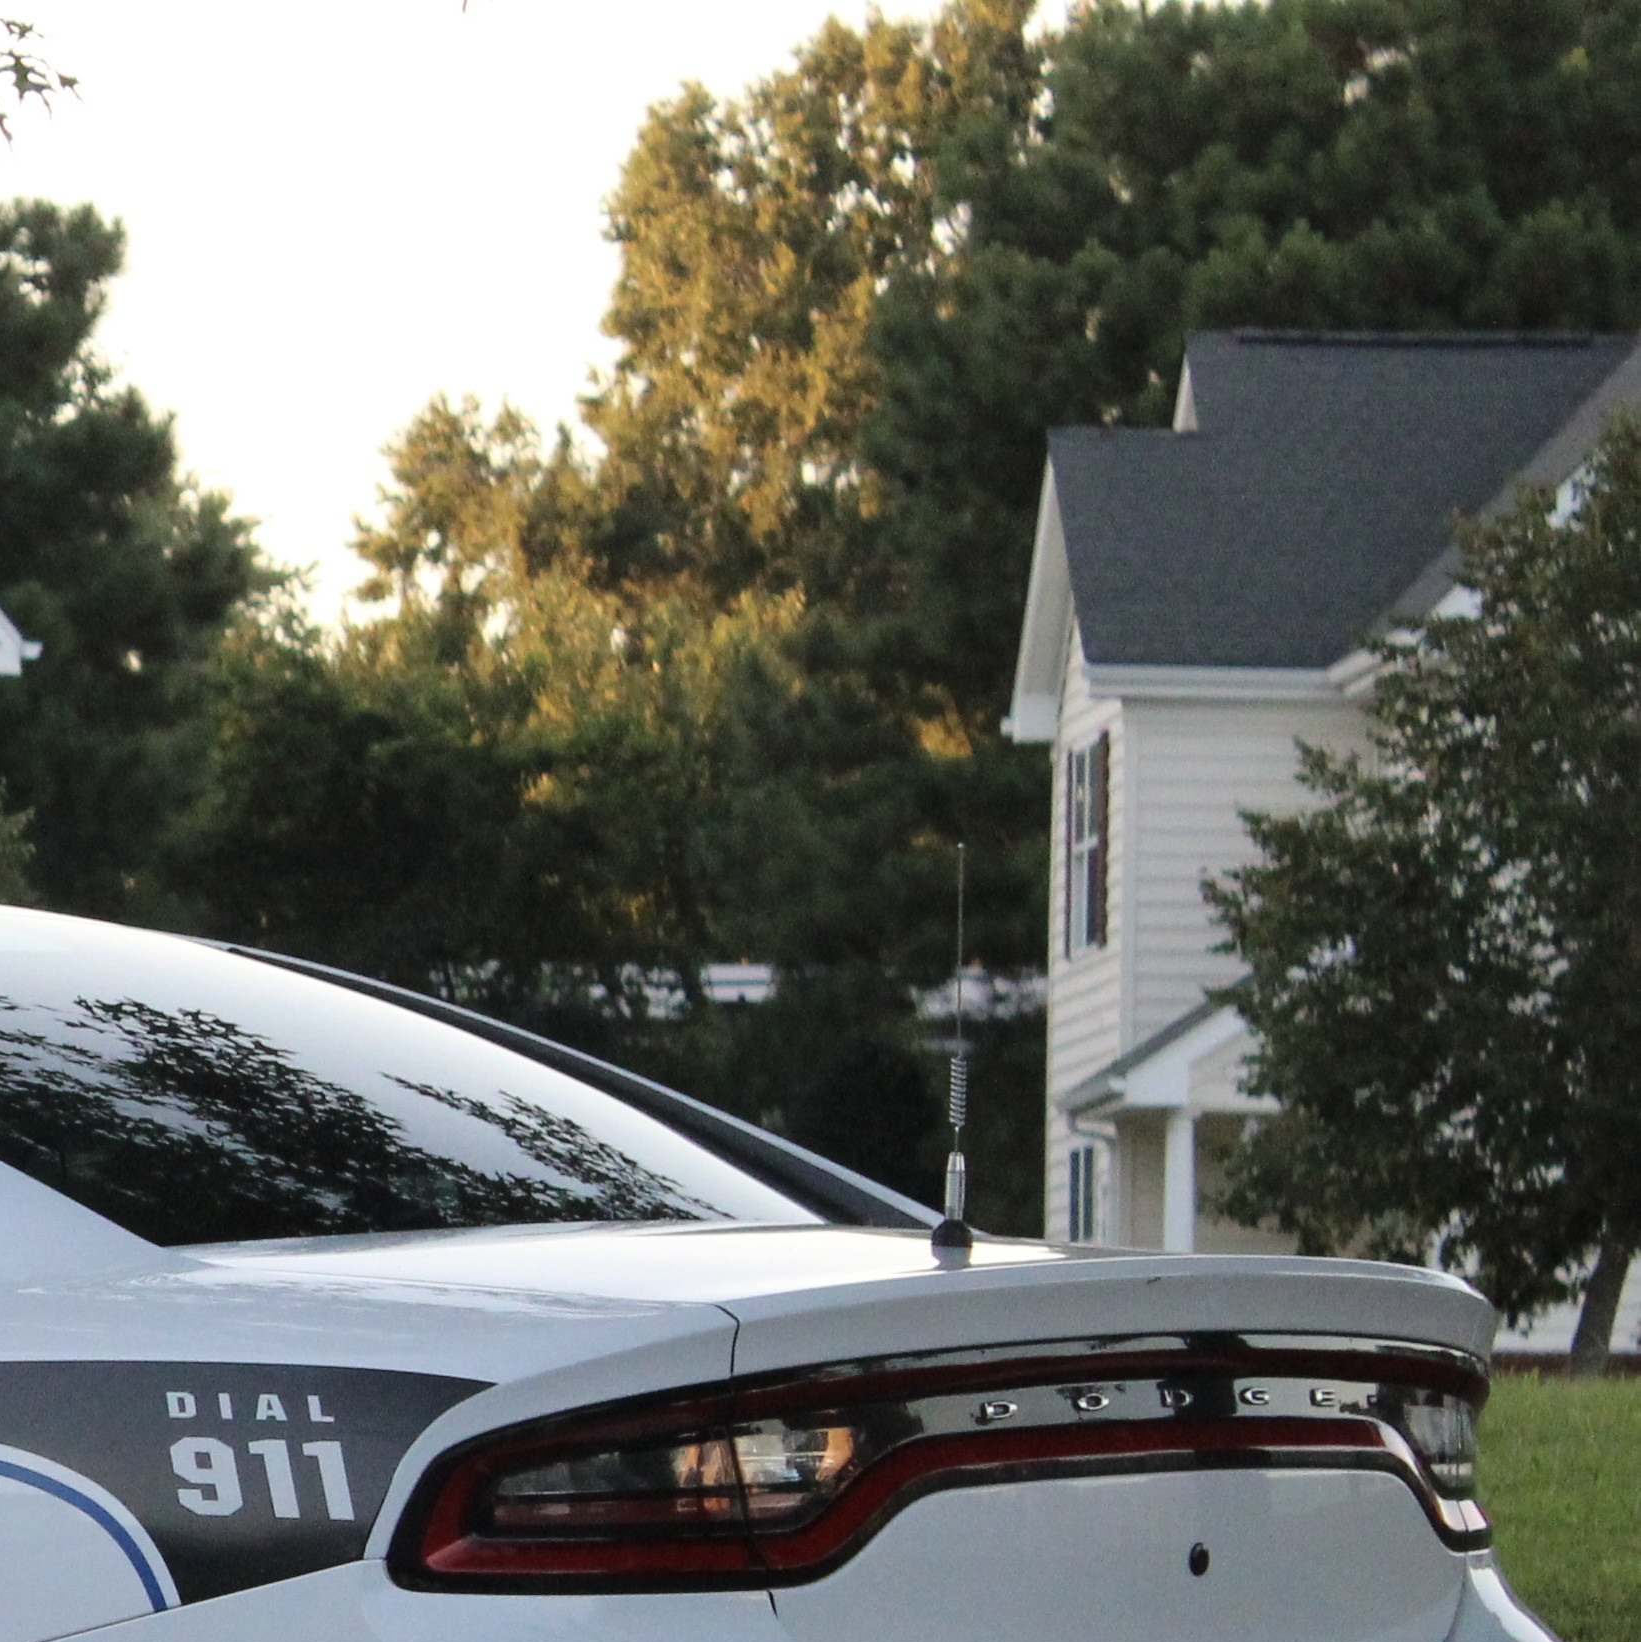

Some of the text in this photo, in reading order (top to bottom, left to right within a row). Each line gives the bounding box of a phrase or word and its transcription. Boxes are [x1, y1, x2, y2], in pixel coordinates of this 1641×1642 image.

[166, 1391, 335, 1423] DIAL
[980, 1388, 1335, 1421] DODGE
[170, 1436, 355, 1520] 911
